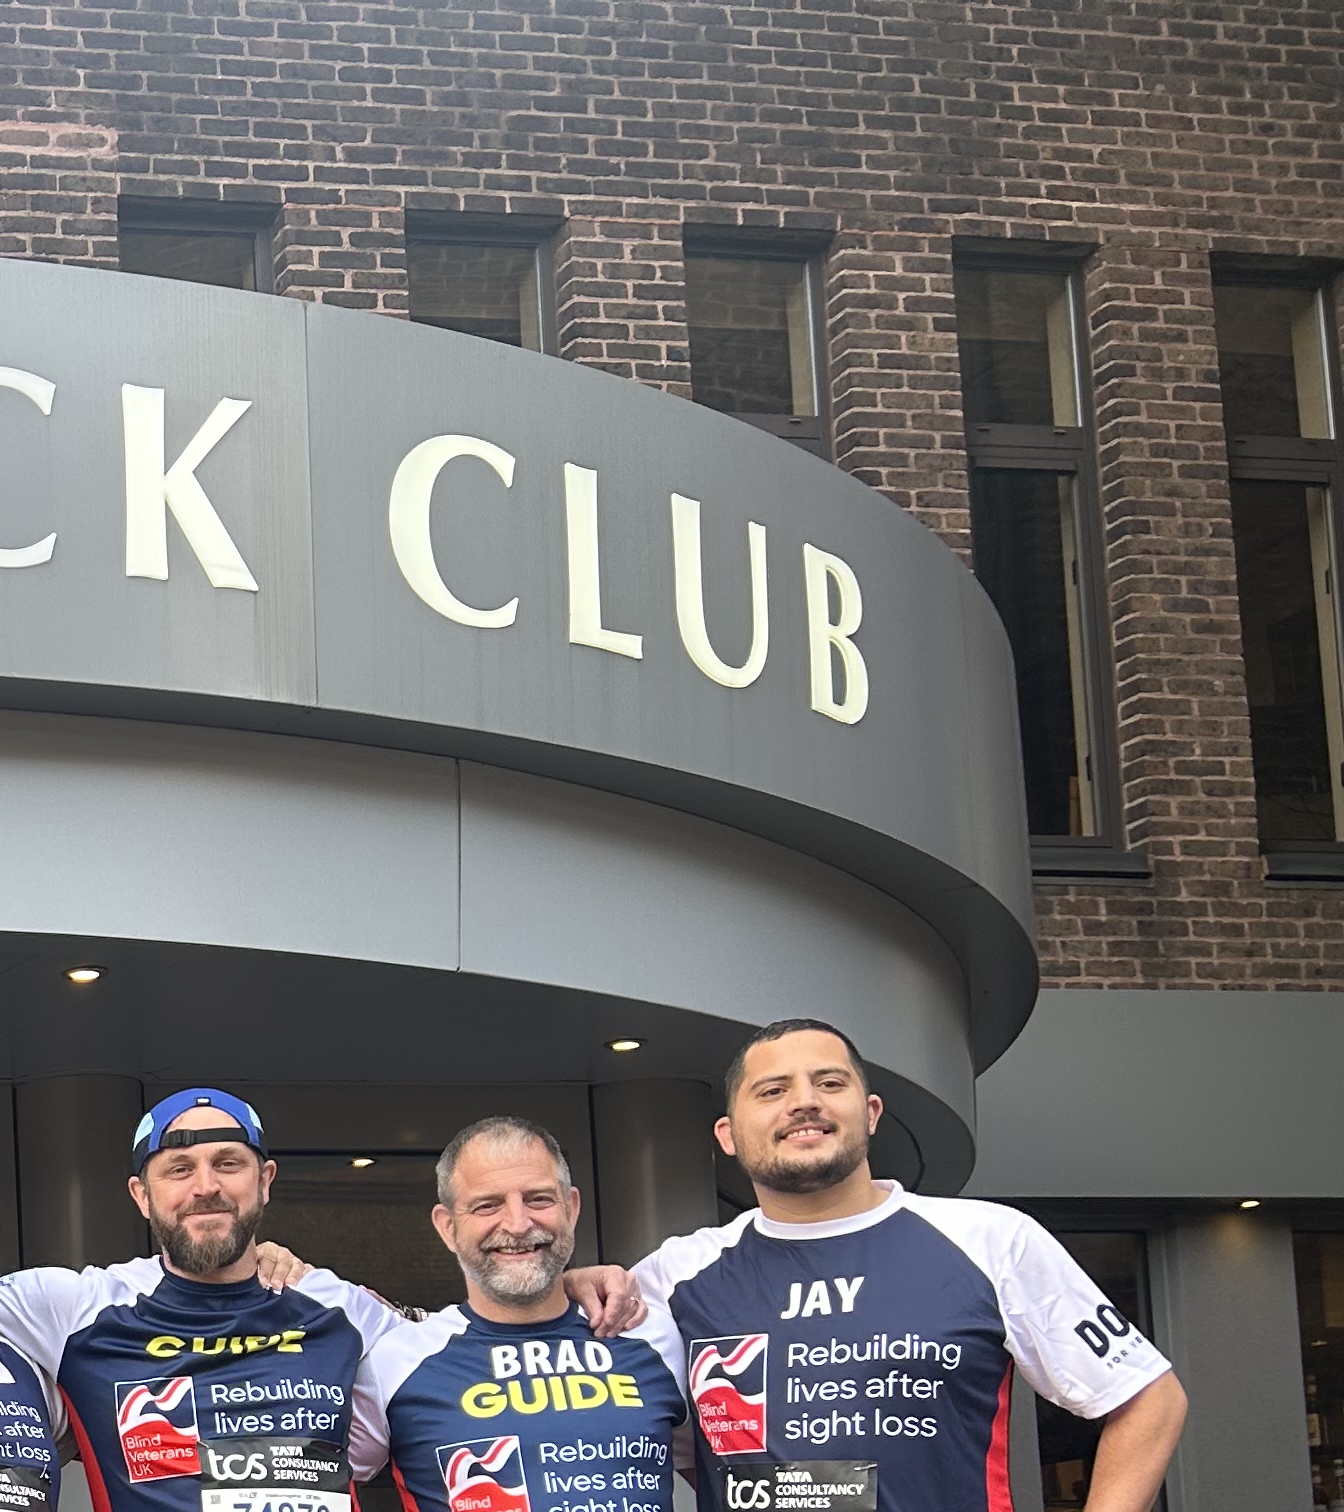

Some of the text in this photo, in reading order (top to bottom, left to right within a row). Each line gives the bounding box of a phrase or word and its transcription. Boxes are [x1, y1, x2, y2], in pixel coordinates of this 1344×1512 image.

[389, 433, 868, 726] CLUB
[781, 1276, 865, 1320] JAY
[492, 1339, 613, 1379] BRAD
[788, 1333, 962, 1370] Rebuilding
[210, 1378, 345, 1406] Rebuilding
[462, 1374, 644, 1418] GUIDE
[787, 1370, 944, 1404] lives after
[699, 1402, 727, 1416] Blind
[4, 1422, 44, 1439] after
[215, 1407, 339, 1434] lives after
[785, 1408, 938, 1444] sight loss
[126, 1434, 161, 1449] Blind
[270, 1446, 303, 1457] TATA
[540, 1435, 667, 1466] Rebuilding
[16, 1444, 51, 1462] loss
[129, 1446, 194, 1463] Veterans
[134, 1464, 153, 1477] UK
[208, 1449, 267, 1481] tcs
[272, 1458, 339, 1473] CONSULTANCY
[274, 1470, 319, 1482] SERVICES
[544, 1466, 661, 1493] lives after
[776, 1471, 812, 1482] TATA
[727, 1473, 771, 1510] tcs
[775, 1484, 864, 1496] CONSULTANCY
[455, 1497, 491, 1511] Blind
[775, 1498, 831, 1509] SERVICES
